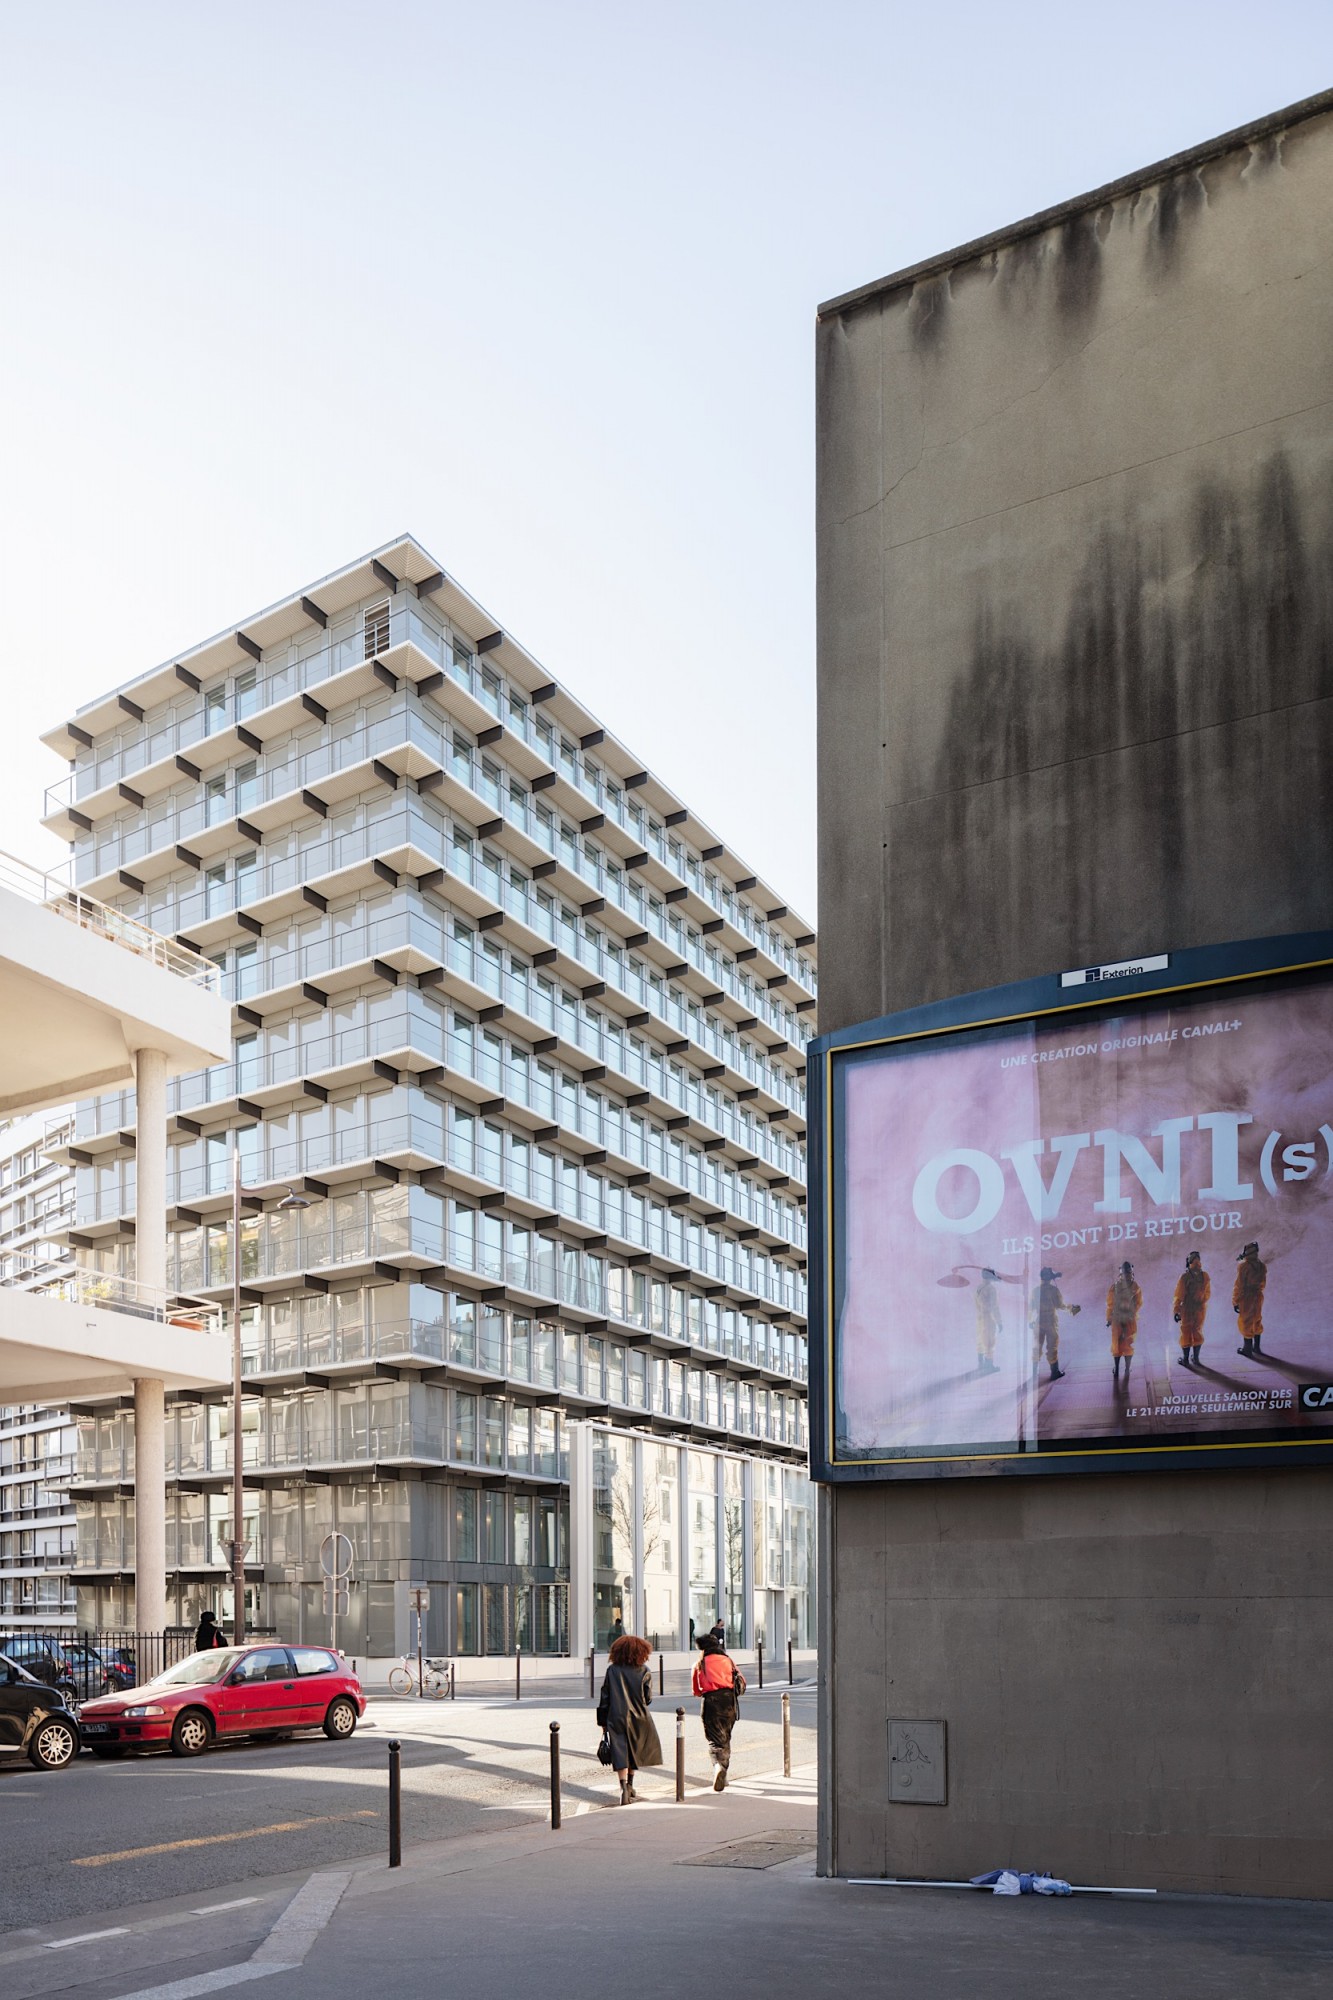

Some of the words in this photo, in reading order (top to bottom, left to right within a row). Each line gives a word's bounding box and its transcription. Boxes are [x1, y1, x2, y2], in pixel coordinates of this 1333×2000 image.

[1102, 966, 1143, 980] Exterion
[1000, 1054, 1027, 1068] UNE
[1030, 1043, 1098, 1063] CREATION
[1101, 1029, 1178, 1052] ORIGINALE
[1181, 1020, 1242, 1039] CANAL+
[1001, 1236, 1035, 1255] ILS
[1040, 1226, 1102, 1251] SONT
[1107, 1222, 1138, 1242] DE
[1144, 1211, 1243, 1238] RETOUR
[1162, 1393, 1220, 1405] NOUVELLE
[1223, 1390, 1267, 1402] SAISON
[1271, 1389, 1292, 1399] DES
[1126, 1408, 1137, 1417] LE
[1140, 1408, 1151, 1417] 21
[1154, 1405, 1198, 1415] FEVRIER
[1200, 1401, 1266, 1413] SEULEMENT
[1268, 1400, 1292, 1410] SUR
